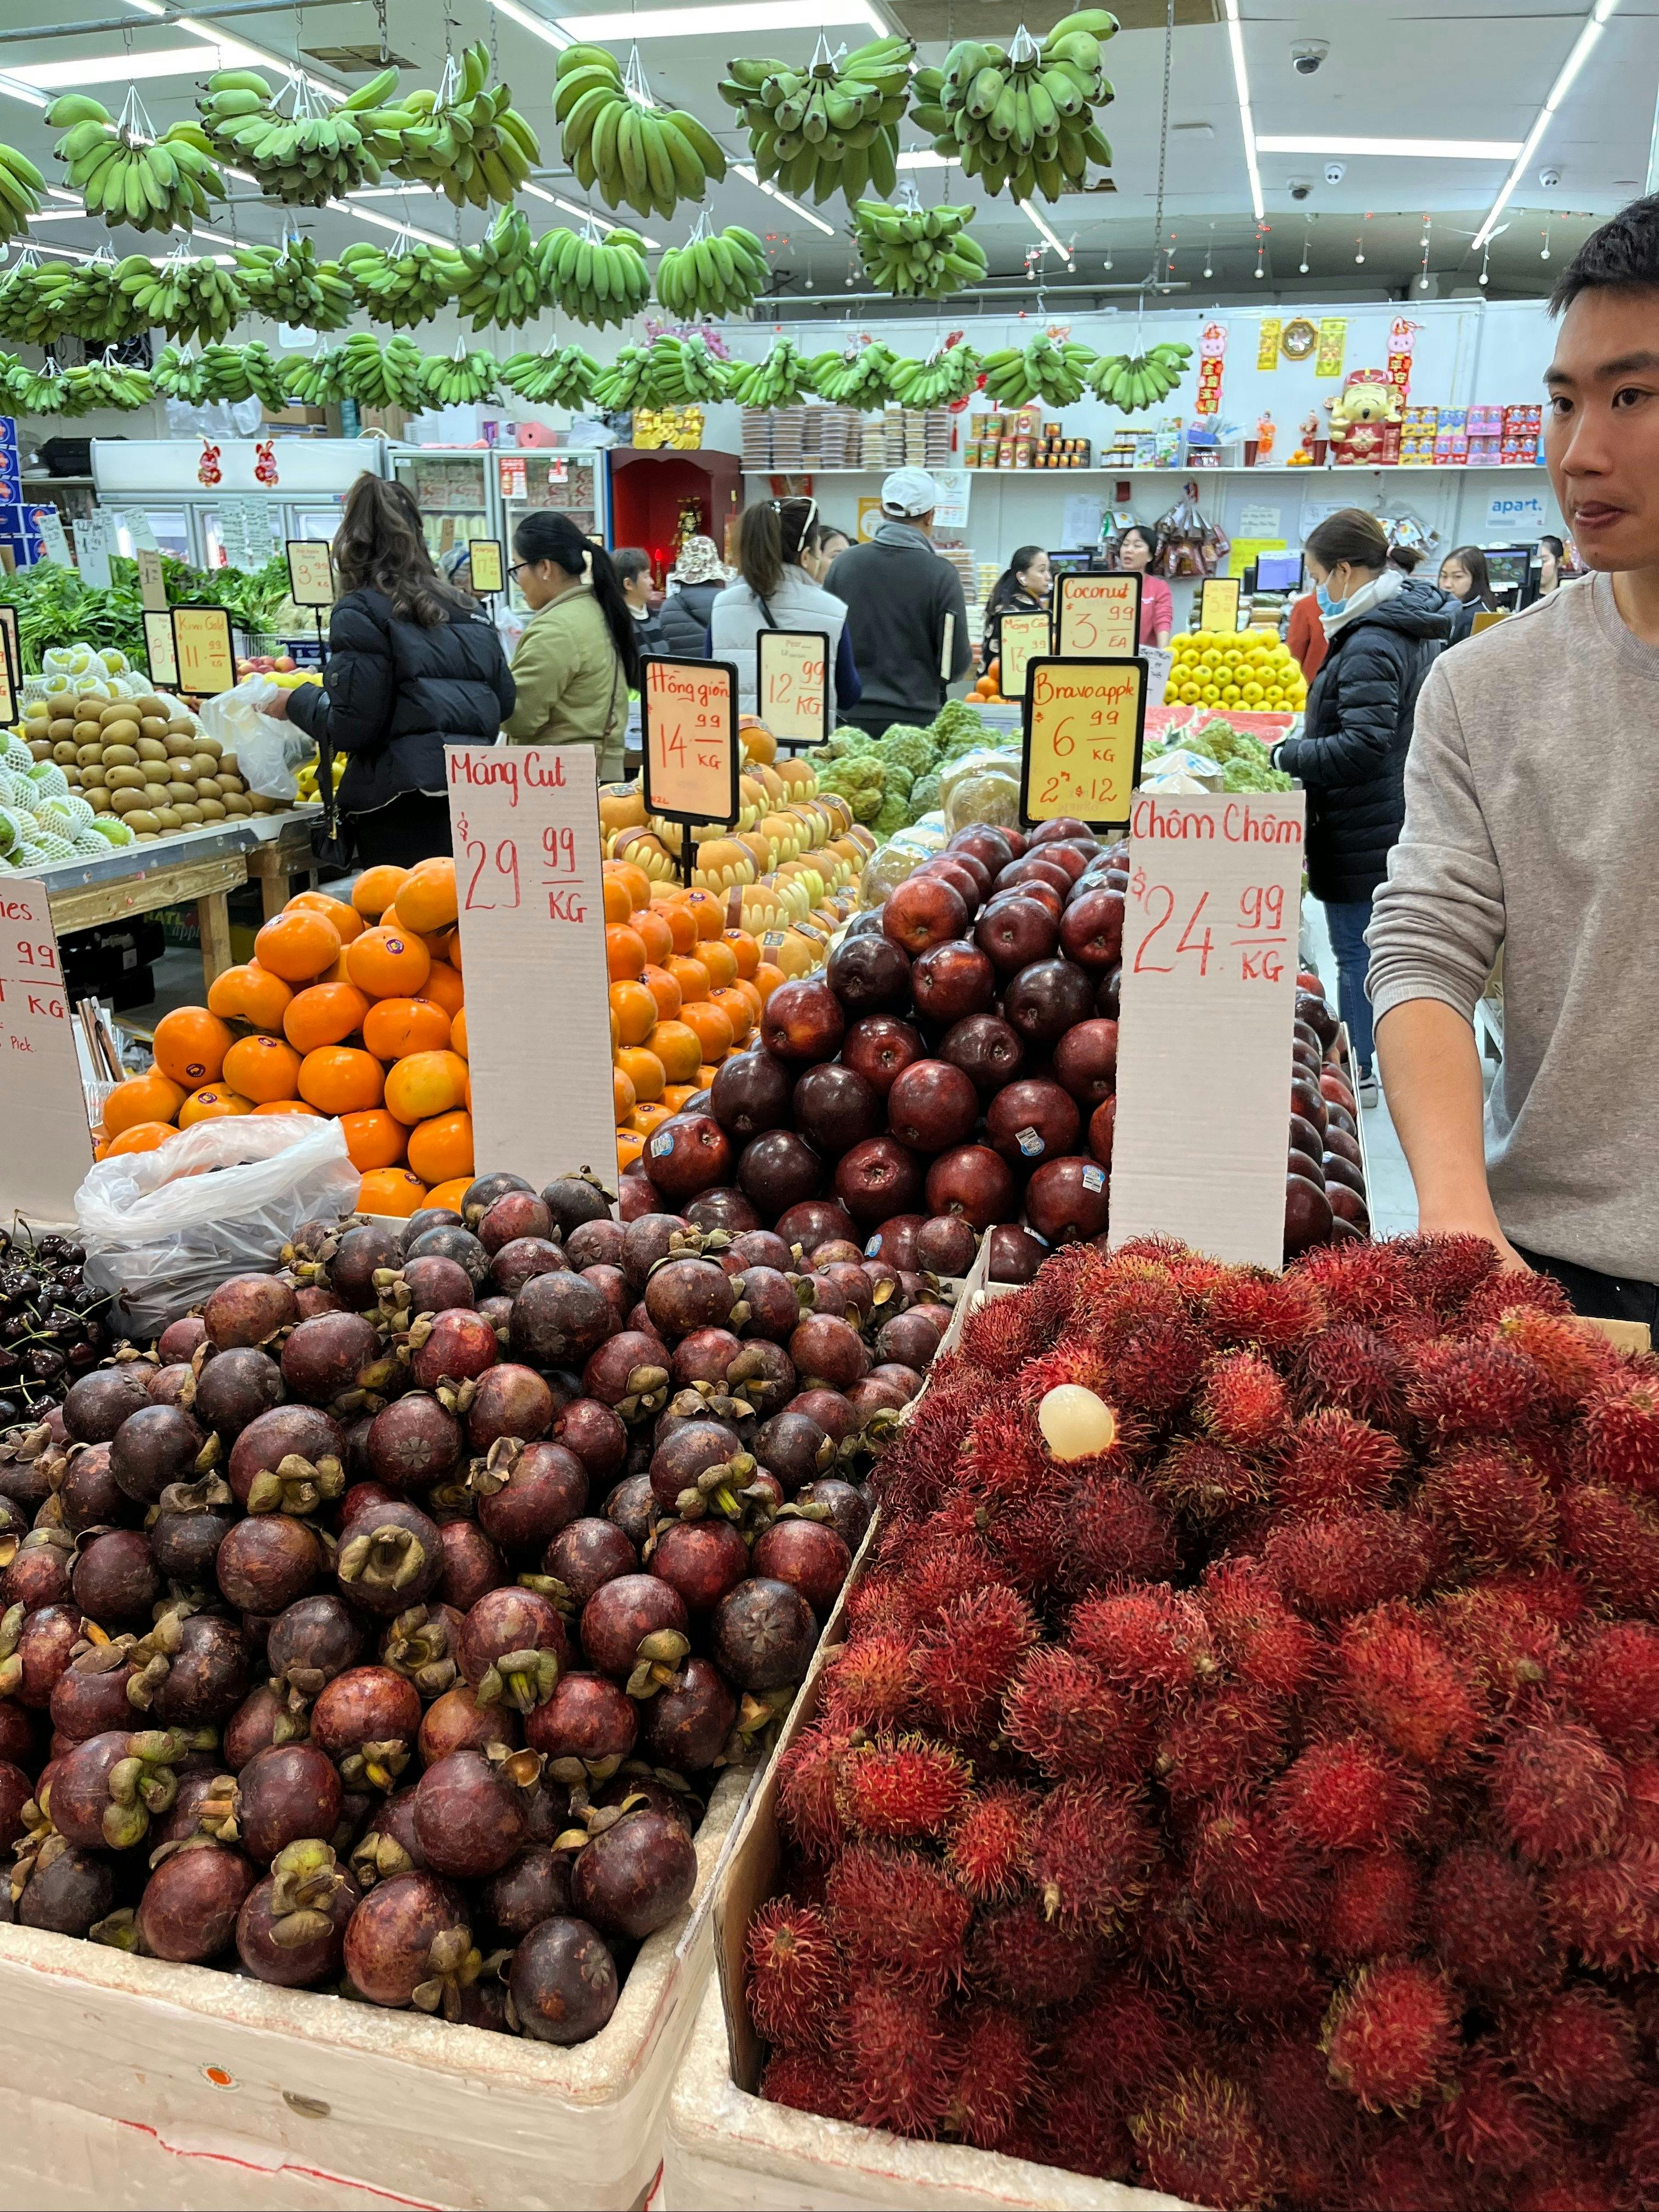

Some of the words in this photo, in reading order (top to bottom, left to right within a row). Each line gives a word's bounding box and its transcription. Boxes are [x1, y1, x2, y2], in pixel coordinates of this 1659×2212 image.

[1065, 580, 1130, 598] Coconut
[1108, 636, 1127, 648] EA
[800, 661, 825, 685] 99
[795, 695, 823, 715] KG
[695, 714, 720, 728] 99
[1090, 710, 1119, 726] 99
[697, 754, 721, 770] KG
[1093, 749, 1115, 763] KG
[1133, 800, 1215, 839] Chôm
[1223, 803, 1301, 844] Chôm
[541, 827, 575, 873] 99
[549, 890, 588, 924] KG
[1237, 884, 1284, 930] 99
[17, 941, 55, 969] 99
[1242, 950, 1284, 982] KG
[28, 994, 64, 1019] KG
